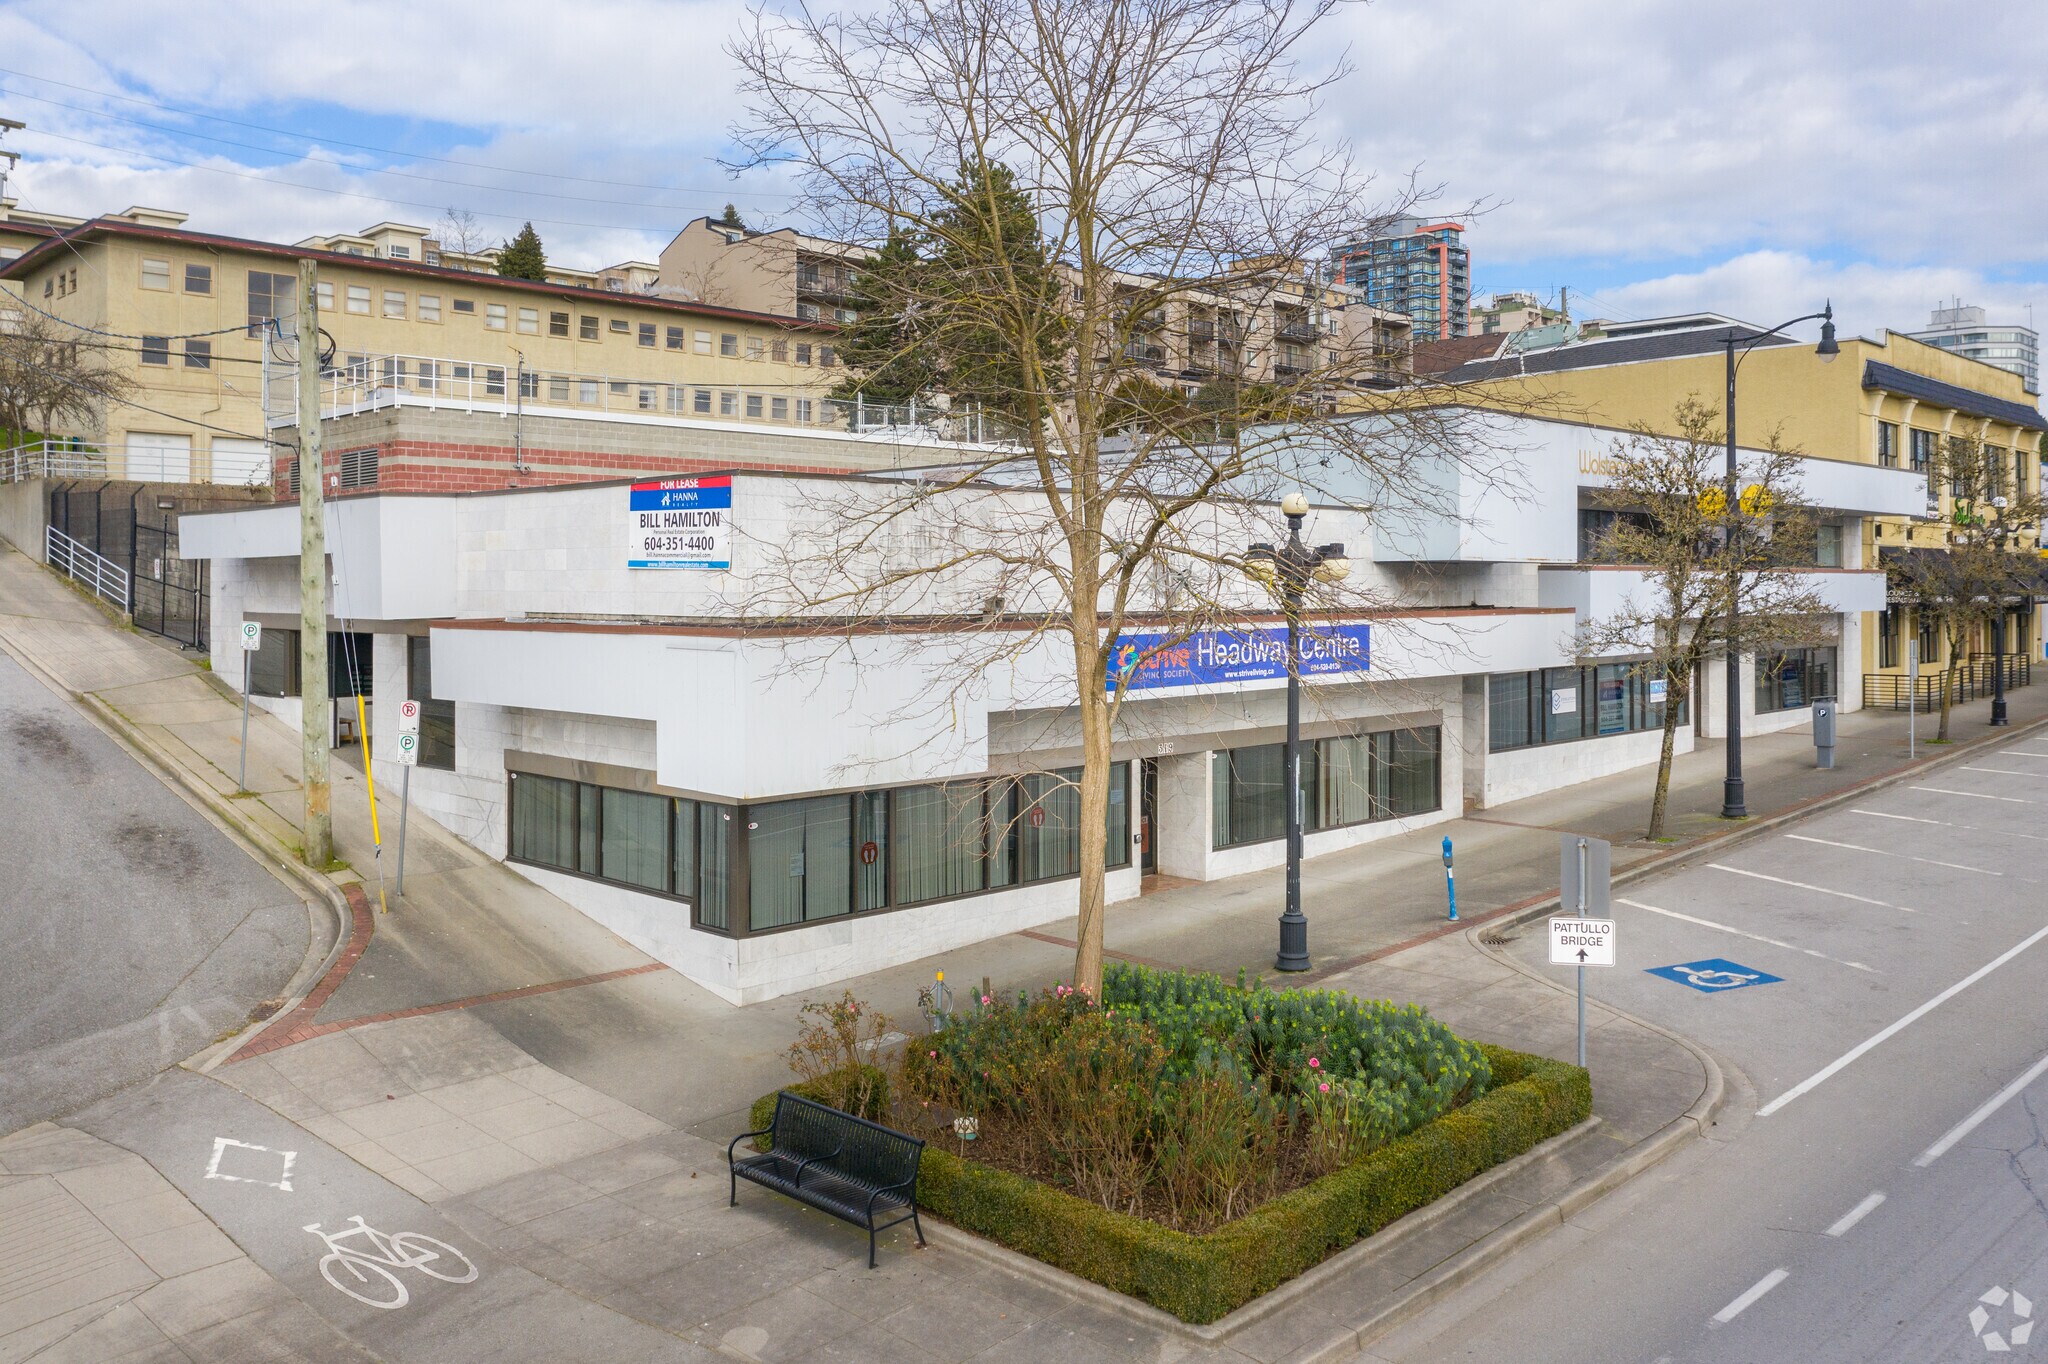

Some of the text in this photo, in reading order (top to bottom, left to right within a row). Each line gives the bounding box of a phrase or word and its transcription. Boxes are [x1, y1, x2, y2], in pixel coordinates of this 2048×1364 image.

[676, 478, 699, 489] LEASE
[672, 492, 698, 502] HANNA
[640, 511, 720, 528] BILL HAMILTON
[644, 536, 715, 551] 604-351-4400
[1299, 632, 1360, 660] Centre
[1163, 669, 1190, 679] SOCIETY
[1224, 668, 1275, 678] www.striveliving.ca
[1554, 922, 1610, 934] PATTULLO
[1560, 935, 1603, 947] BRIDGE
